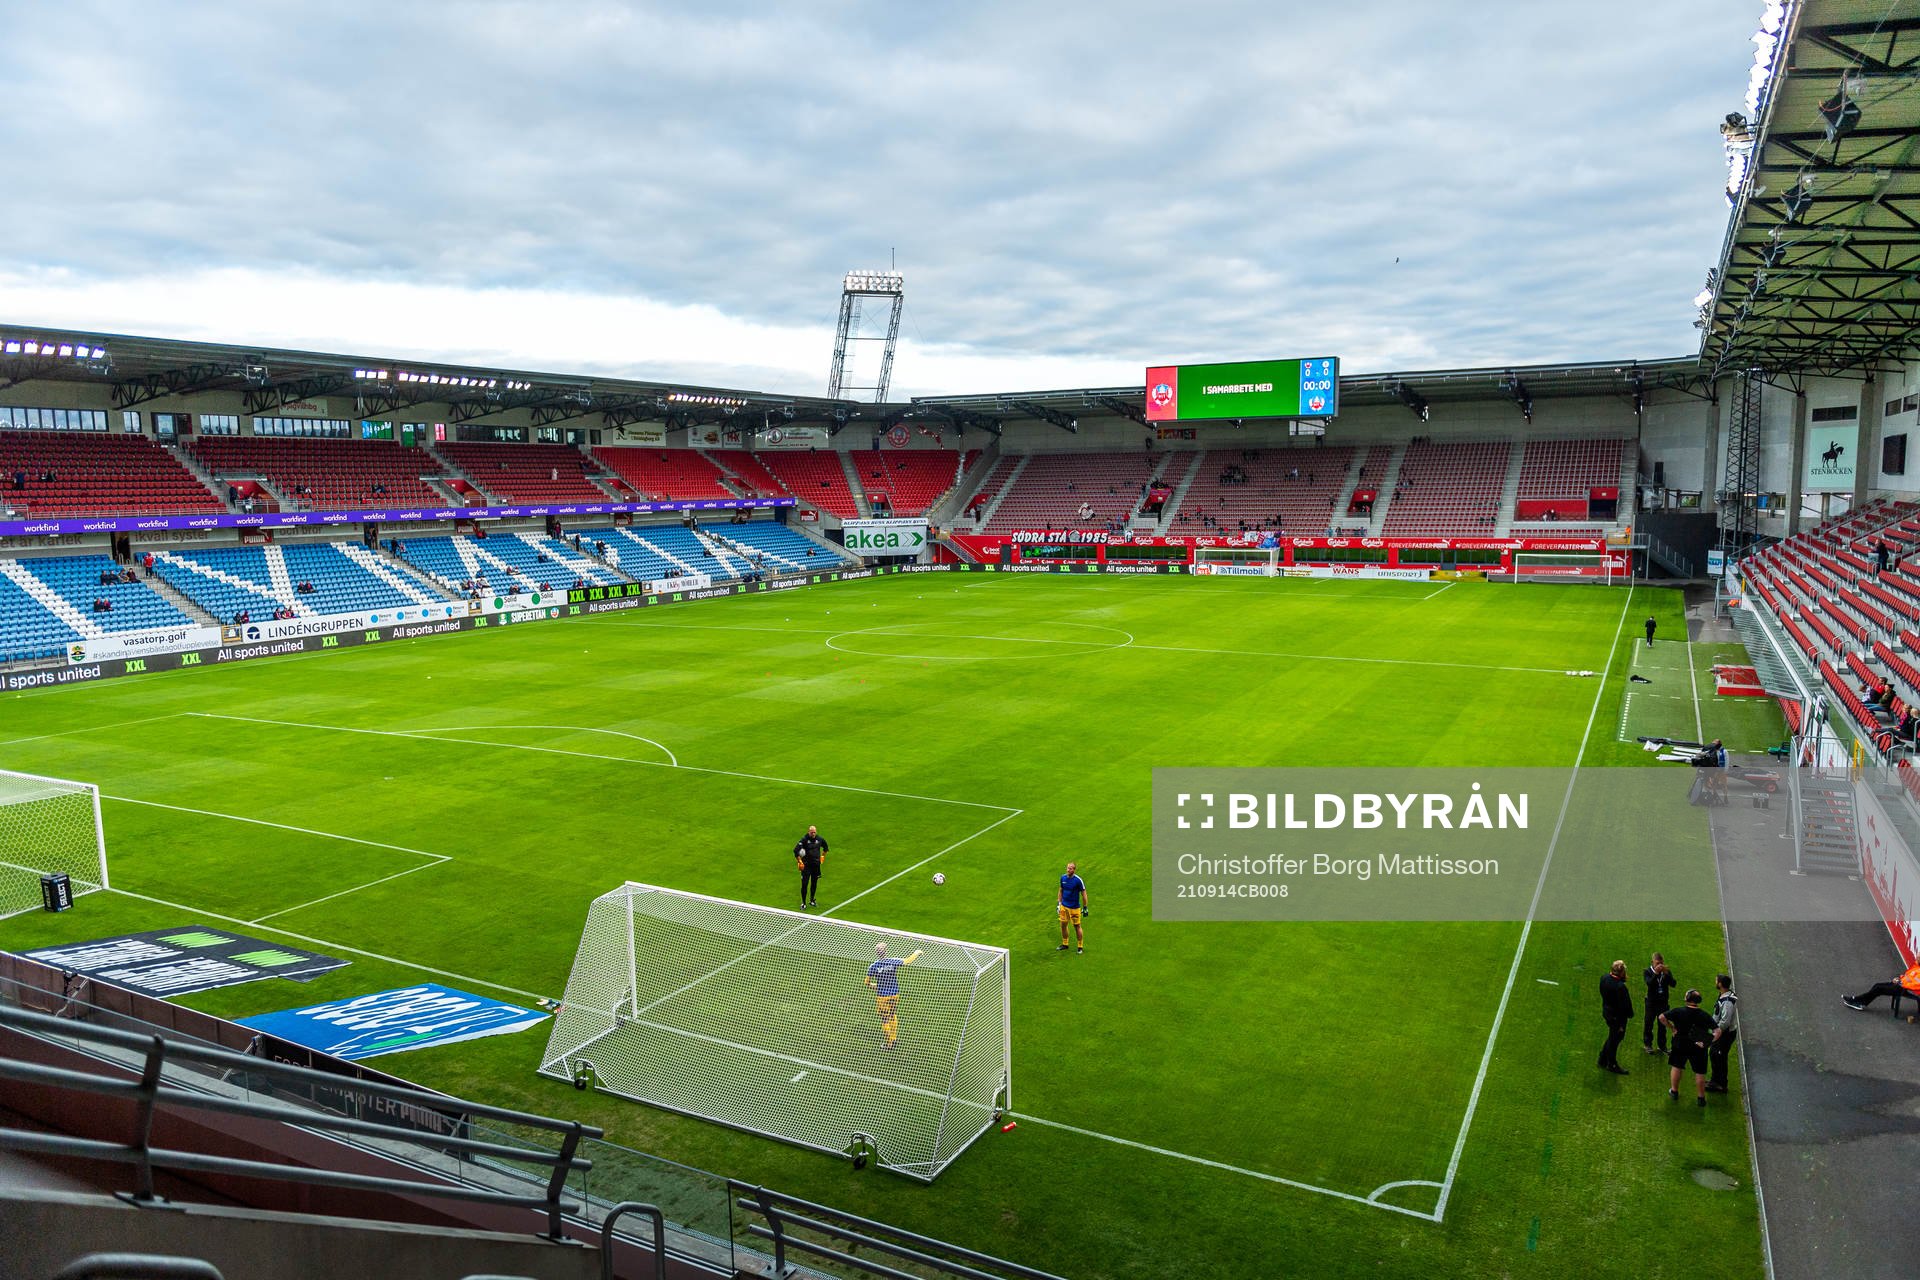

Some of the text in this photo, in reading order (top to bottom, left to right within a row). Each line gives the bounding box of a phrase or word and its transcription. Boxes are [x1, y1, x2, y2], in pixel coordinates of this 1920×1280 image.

[1202, 383, 1272, 395] I SAMARBETE MED
[1304, 380, 1330, 390] 00:00
[24, 523, 59, 532] workfind
[84, 522, 116, 530] workfind
[138, 520, 168, 528] workfind
[236, 517, 263, 525] workfind
[846, 529, 899, 549] akea
[1012, 529, 1108, 543] SÖDRA STÅ 1985
[1292, 538, 1314, 546] Carlsberg
[1327, 538, 1349, 547] Carlsberg
[1362, 538, 1384, 547] Carlsberg
[779, 580, 792, 588] sports
[793, 578, 806, 586] united
[570, 584, 640, 602] XXL XXL XXL XXL
[673, 593, 682, 601] XXL
[697, 590, 713, 599] sports
[714, 588, 729, 597] united
[589, 599, 638, 612] All sports united
[648, 596, 657, 604] XXL
[511, 609, 546, 623] SUPERETTAN
[569, 605, 580, 615] XXL
[268, 618, 364, 638] LINDÉNGRUPPEN
[475, 617, 487, 626] XXL
[392, 620, 460, 638] All sports united
[123, 631, 186, 646] vasatorp.golf
[322, 636, 338, 647] XXL
[365, 630, 380, 642] XXL
[218, 640, 303, 661] All sports united
[182, 652, 201, 665] XXL
[125, 660, 146, 673] XXL
[10, 672, 55, 689] sports
[58, 665, 101, 682] united
[57, 884, 67, 906] SELECT
[296, 988, 481, 1030] OBOS
